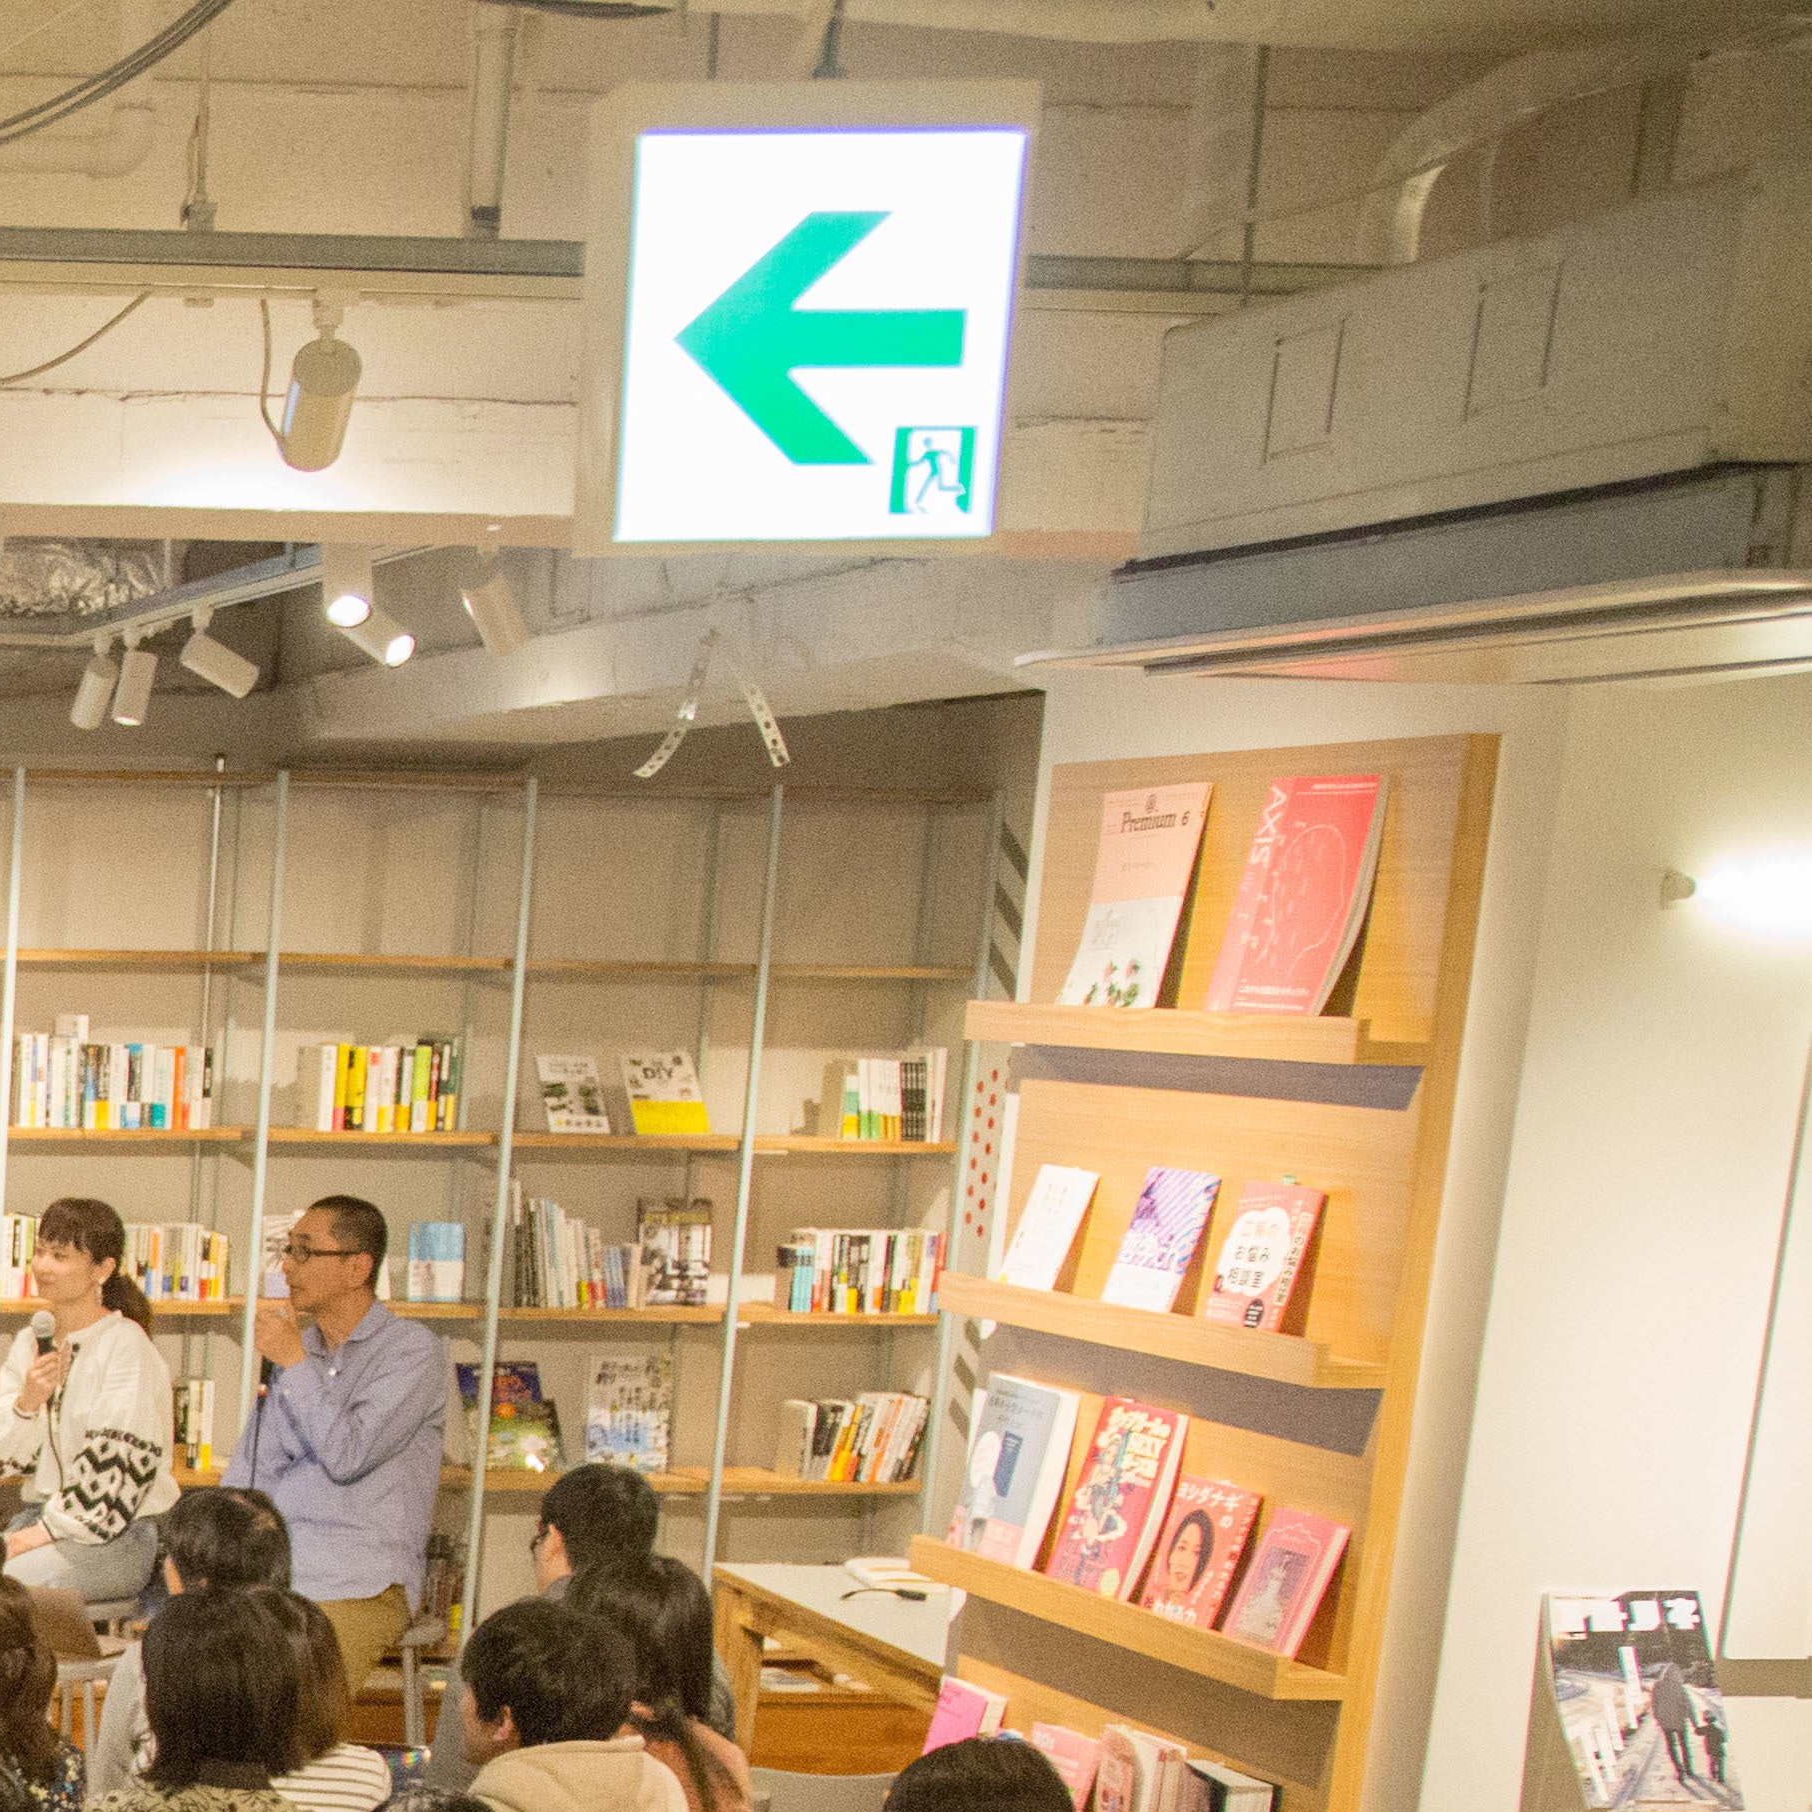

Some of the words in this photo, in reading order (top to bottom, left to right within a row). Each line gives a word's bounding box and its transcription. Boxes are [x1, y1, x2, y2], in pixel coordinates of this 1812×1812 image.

[1120, 811, 1175, 834] Premium
[1250, 785, 1288, 865] AXIS
[1176, 1482, 1244, 1512] ヨシダナギ
[1218, 1515, 1234, 1529] の
